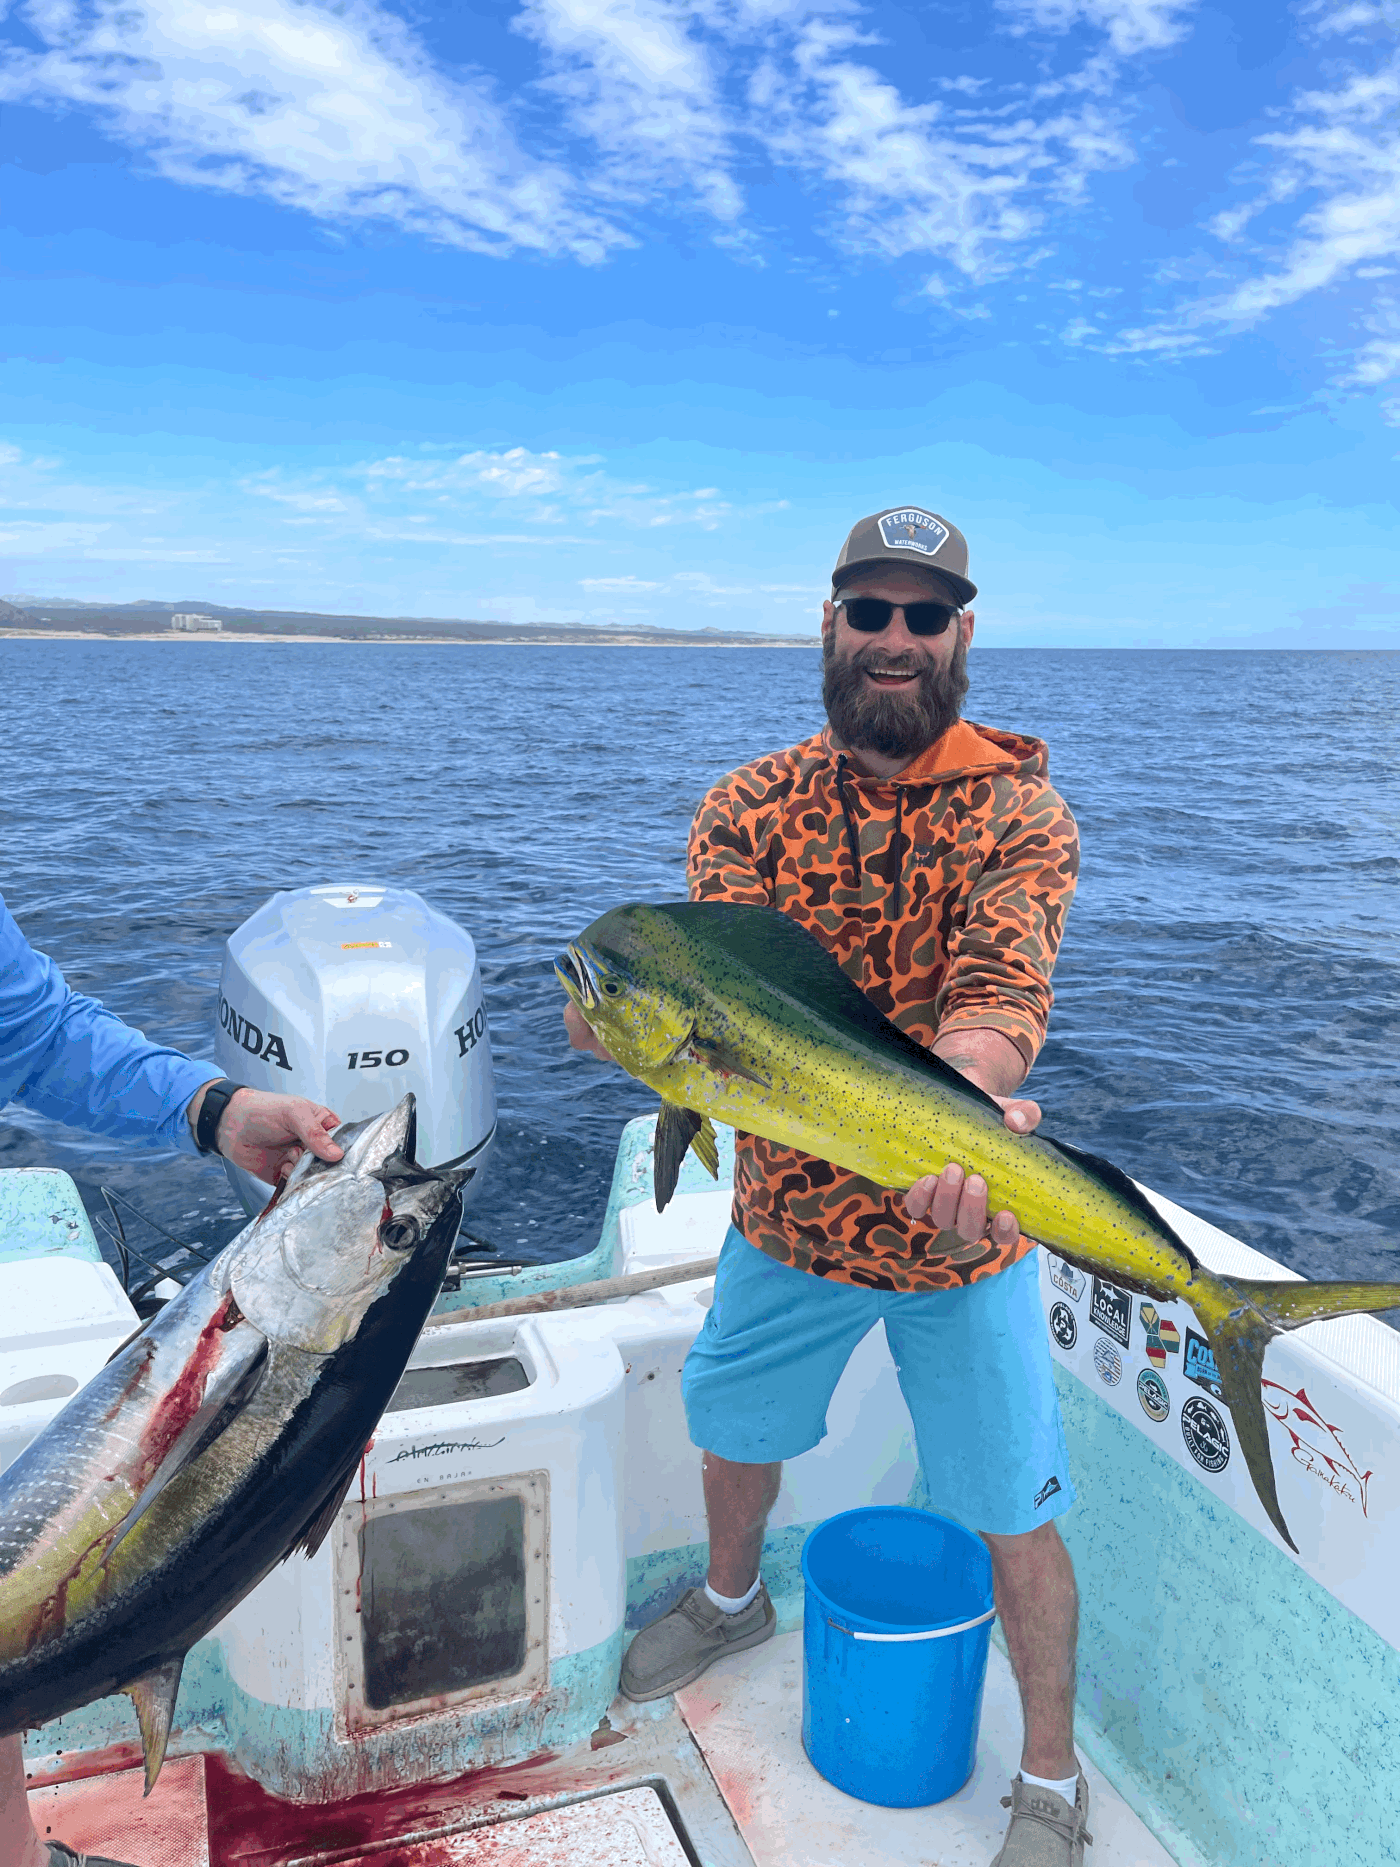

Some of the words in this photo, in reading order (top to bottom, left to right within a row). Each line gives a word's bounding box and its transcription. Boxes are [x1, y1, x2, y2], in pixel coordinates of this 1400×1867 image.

[886, 513, 943, 536] FERGUSON
[894, 539, 928, 551] WATERWORKS
[347, 1049, 410, 1070] 150
[1093, 1307, 1126, 1338] KNOWLEDGE
[1094, 1293, 1127, 1328] LOCAL
[1187, 1338, 1218, 1371] COS
[1183, 1413, 1229, 1458] PELAGIC
